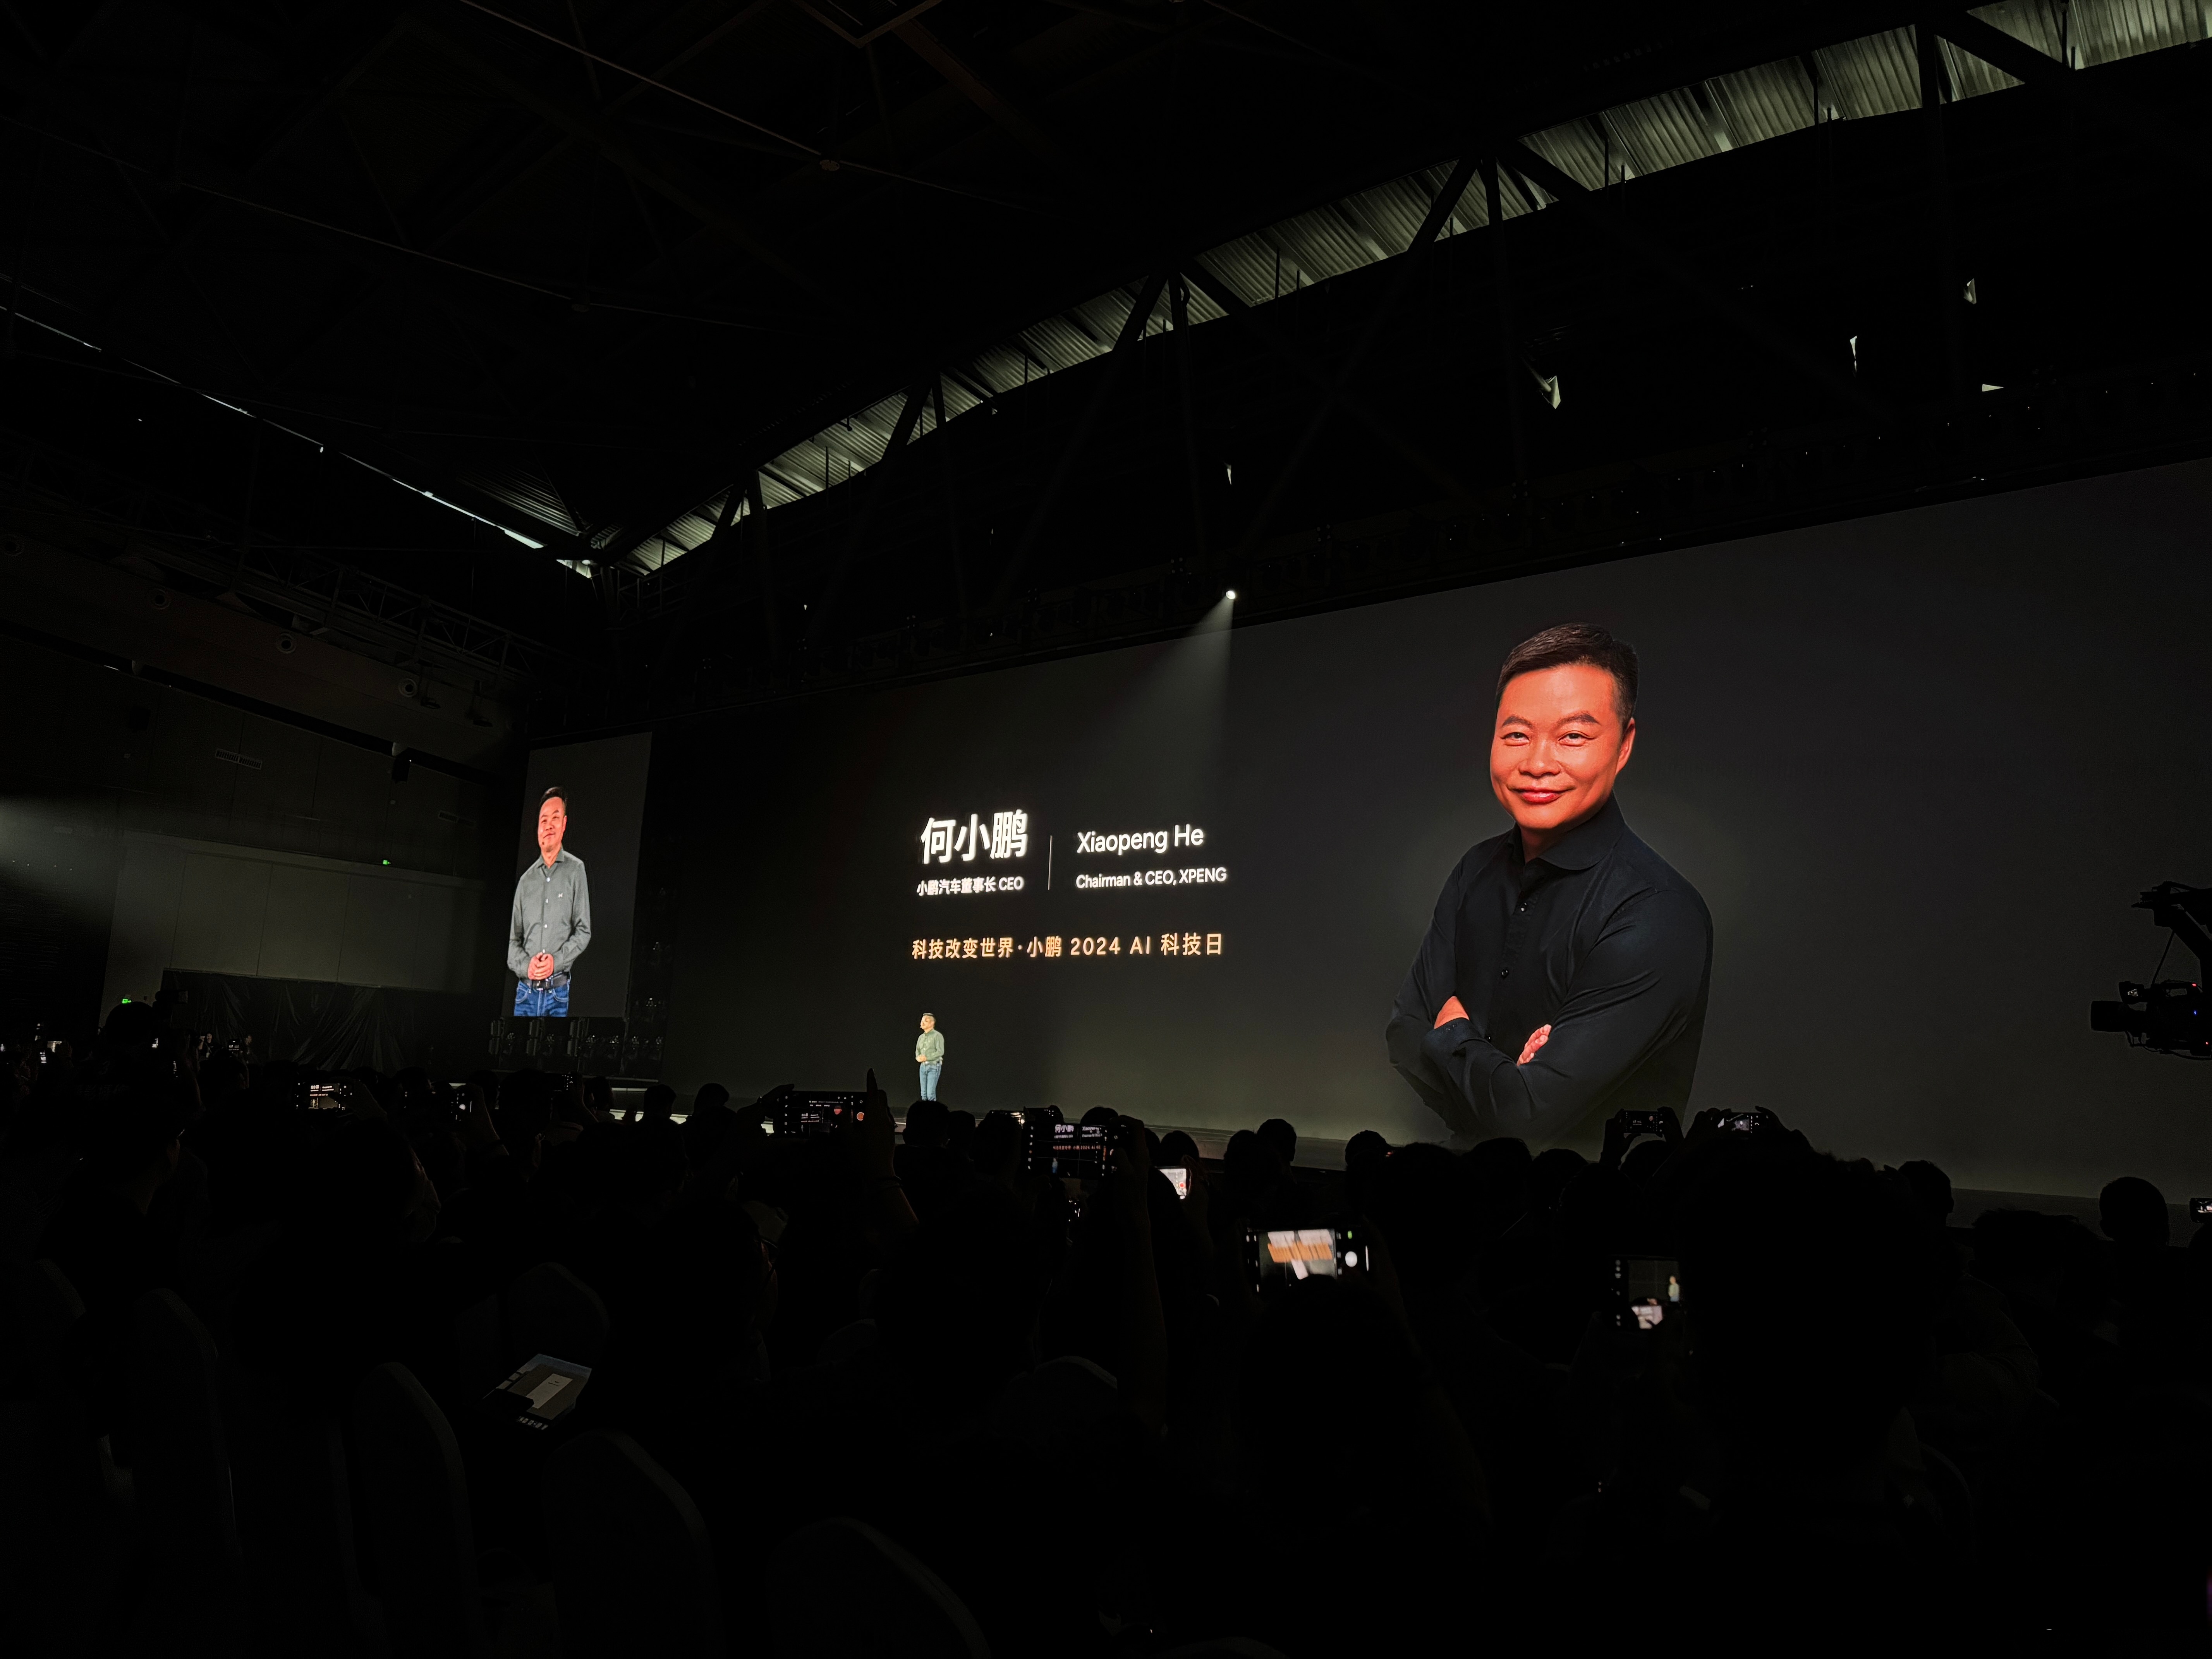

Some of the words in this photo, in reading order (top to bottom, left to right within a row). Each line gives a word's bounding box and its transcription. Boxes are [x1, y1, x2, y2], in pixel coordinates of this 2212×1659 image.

[920, 809, 1028, 864] 何小鹏
[1077, 831, 1169, 855] Xiaopeng
[1175, 824, 1205, 847] He
[917, 876, 997, 896] 小鹏汽车董事长
[998, 876, 1024, 891] CEO
[1076, 874, 1131, 889] Chairman
[1133, 871, 1143, 886] &
[1145, 870, 1178, 886] CEO,
[1179, 867, 1227, 883] XPENG
[1071, 937, 1121, 955] 2024
[1130, 936, 1151, 954] AI
[1161, 933, 1221, 955] 科技日
